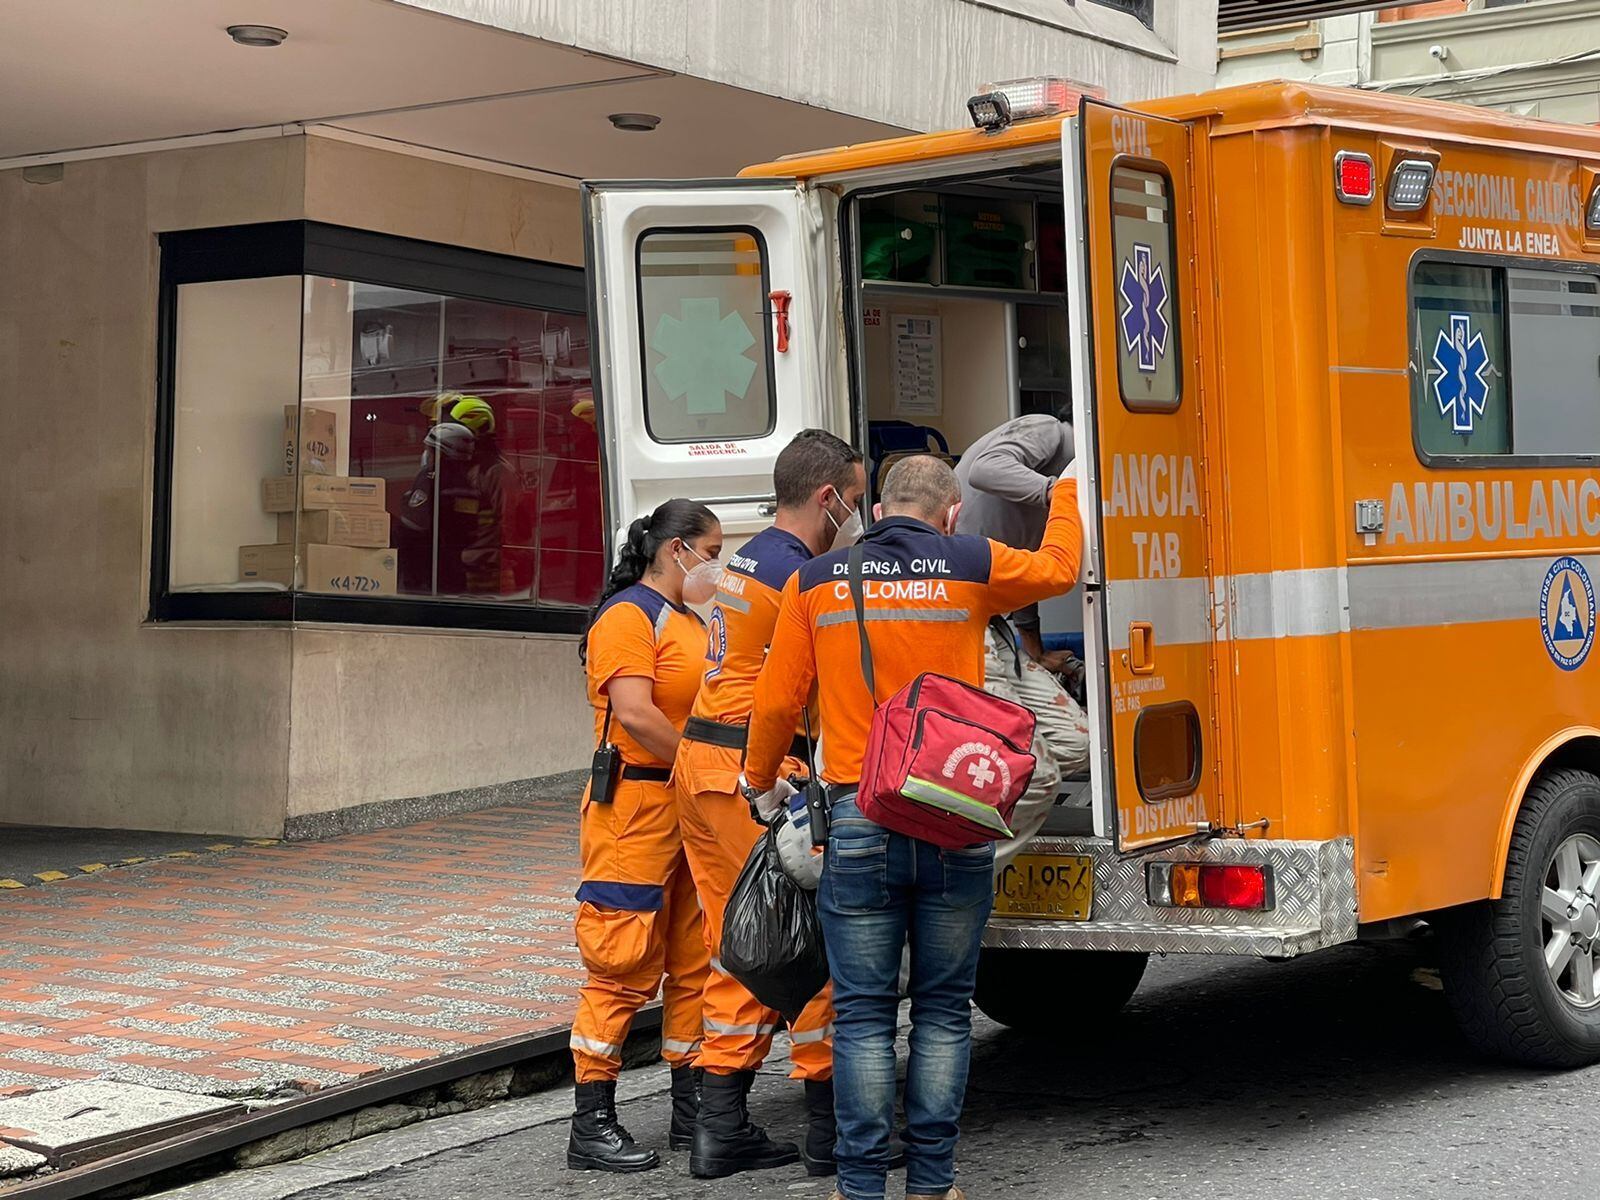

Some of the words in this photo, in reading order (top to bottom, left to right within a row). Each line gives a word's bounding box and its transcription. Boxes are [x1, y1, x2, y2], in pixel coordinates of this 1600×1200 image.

[1111, 114, 1152, 157] CIVIL
[1433, 168, 1521, 221] SECCIONAL
[1525, 178, 1580, 228] CALDAS
[1458, 226, 1503, 251] JUNTA
[1506, 230, 1523, 252] LA
[1526, 232, 1560, 256] ENEA
[688, 448, 747, 456] EMERGENCIA
[833, 561, 901, 576] DEENSA
[910, 558, 951, 573] CIVIL
[1132, 532, 1182, 578] TAB
[834, 581, 949, 601] CLOMBIA
[1540, 572, 1554, 626] DEFENSA
[1553, 558, 1571, 574] CIVIL
[1570, 560, 1596, 628] COLOMBIANA
[1115, 697, 1127, 713] DEL
[1135, 793, 1208, 834] DISTANCIA
